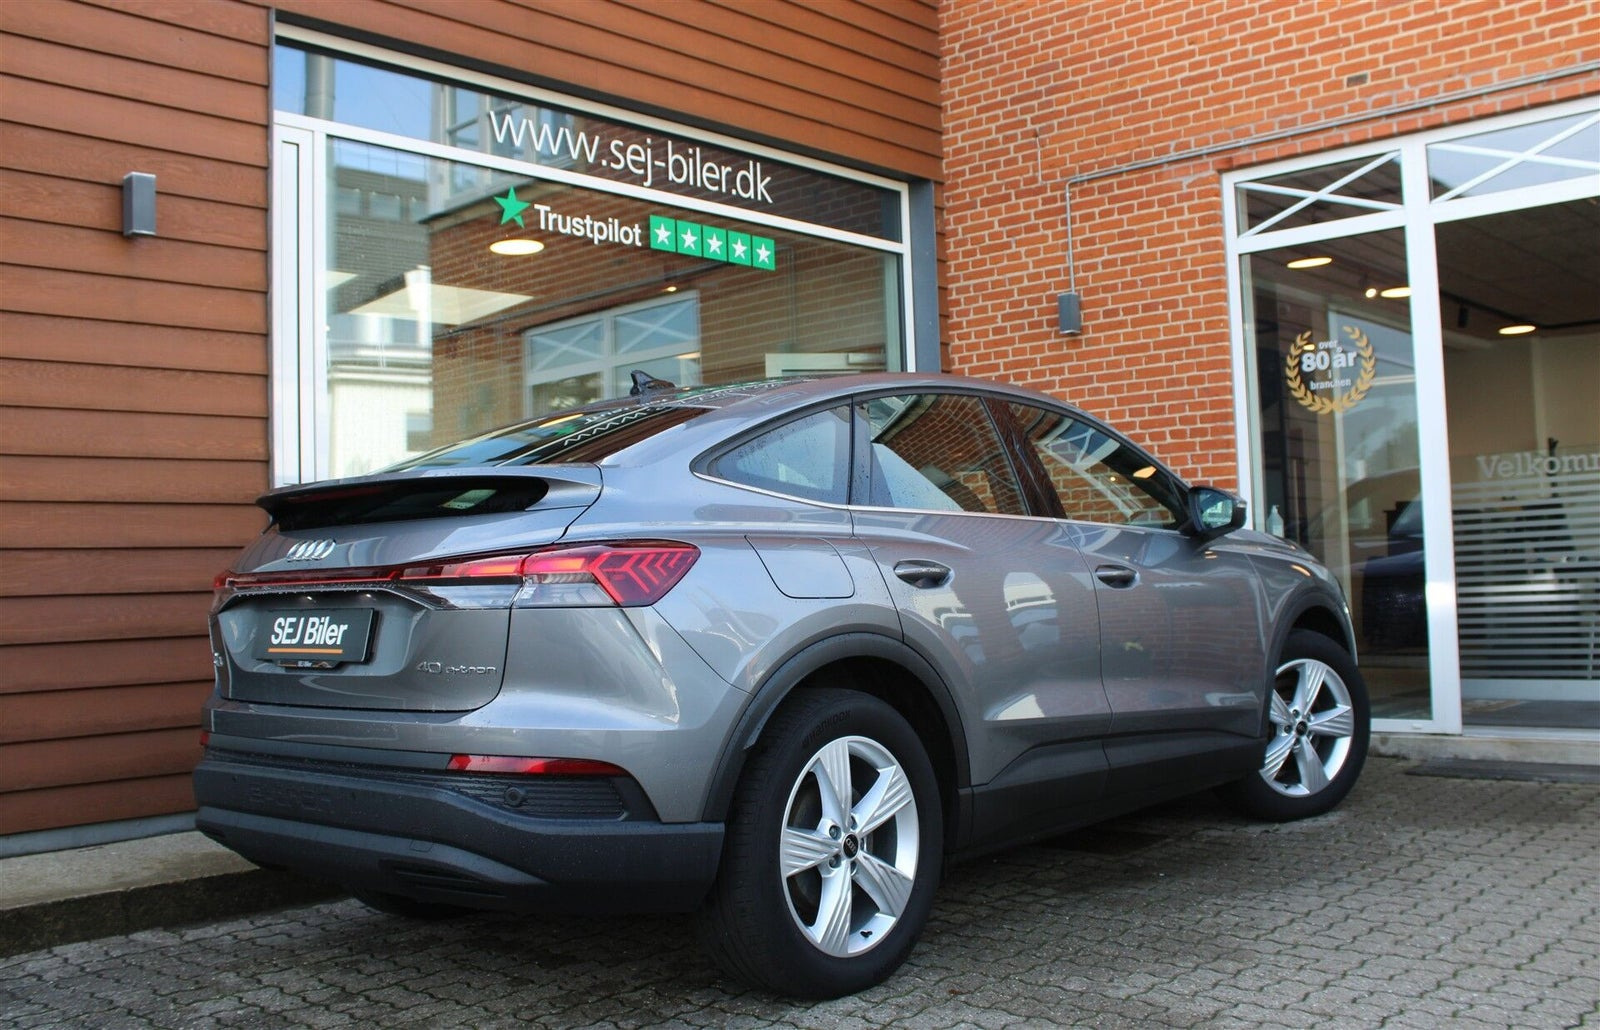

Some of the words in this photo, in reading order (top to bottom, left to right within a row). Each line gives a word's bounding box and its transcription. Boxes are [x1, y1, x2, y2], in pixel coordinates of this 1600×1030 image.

[490, 110, 773, 204] www.sej-biler.dk
[533, 203, 642, 247] Trustpilot
[1301, 350, 1331, 372] 80
[1332, 345, 1358, 369] år
[1318, 340, 1339, 350] over
[1309, 378, 1352, 391] branchen
[270, 616, 306, 645] SEJ
[303, 616, 349, 646] Biler
[416, 660, 442, 674] 40
